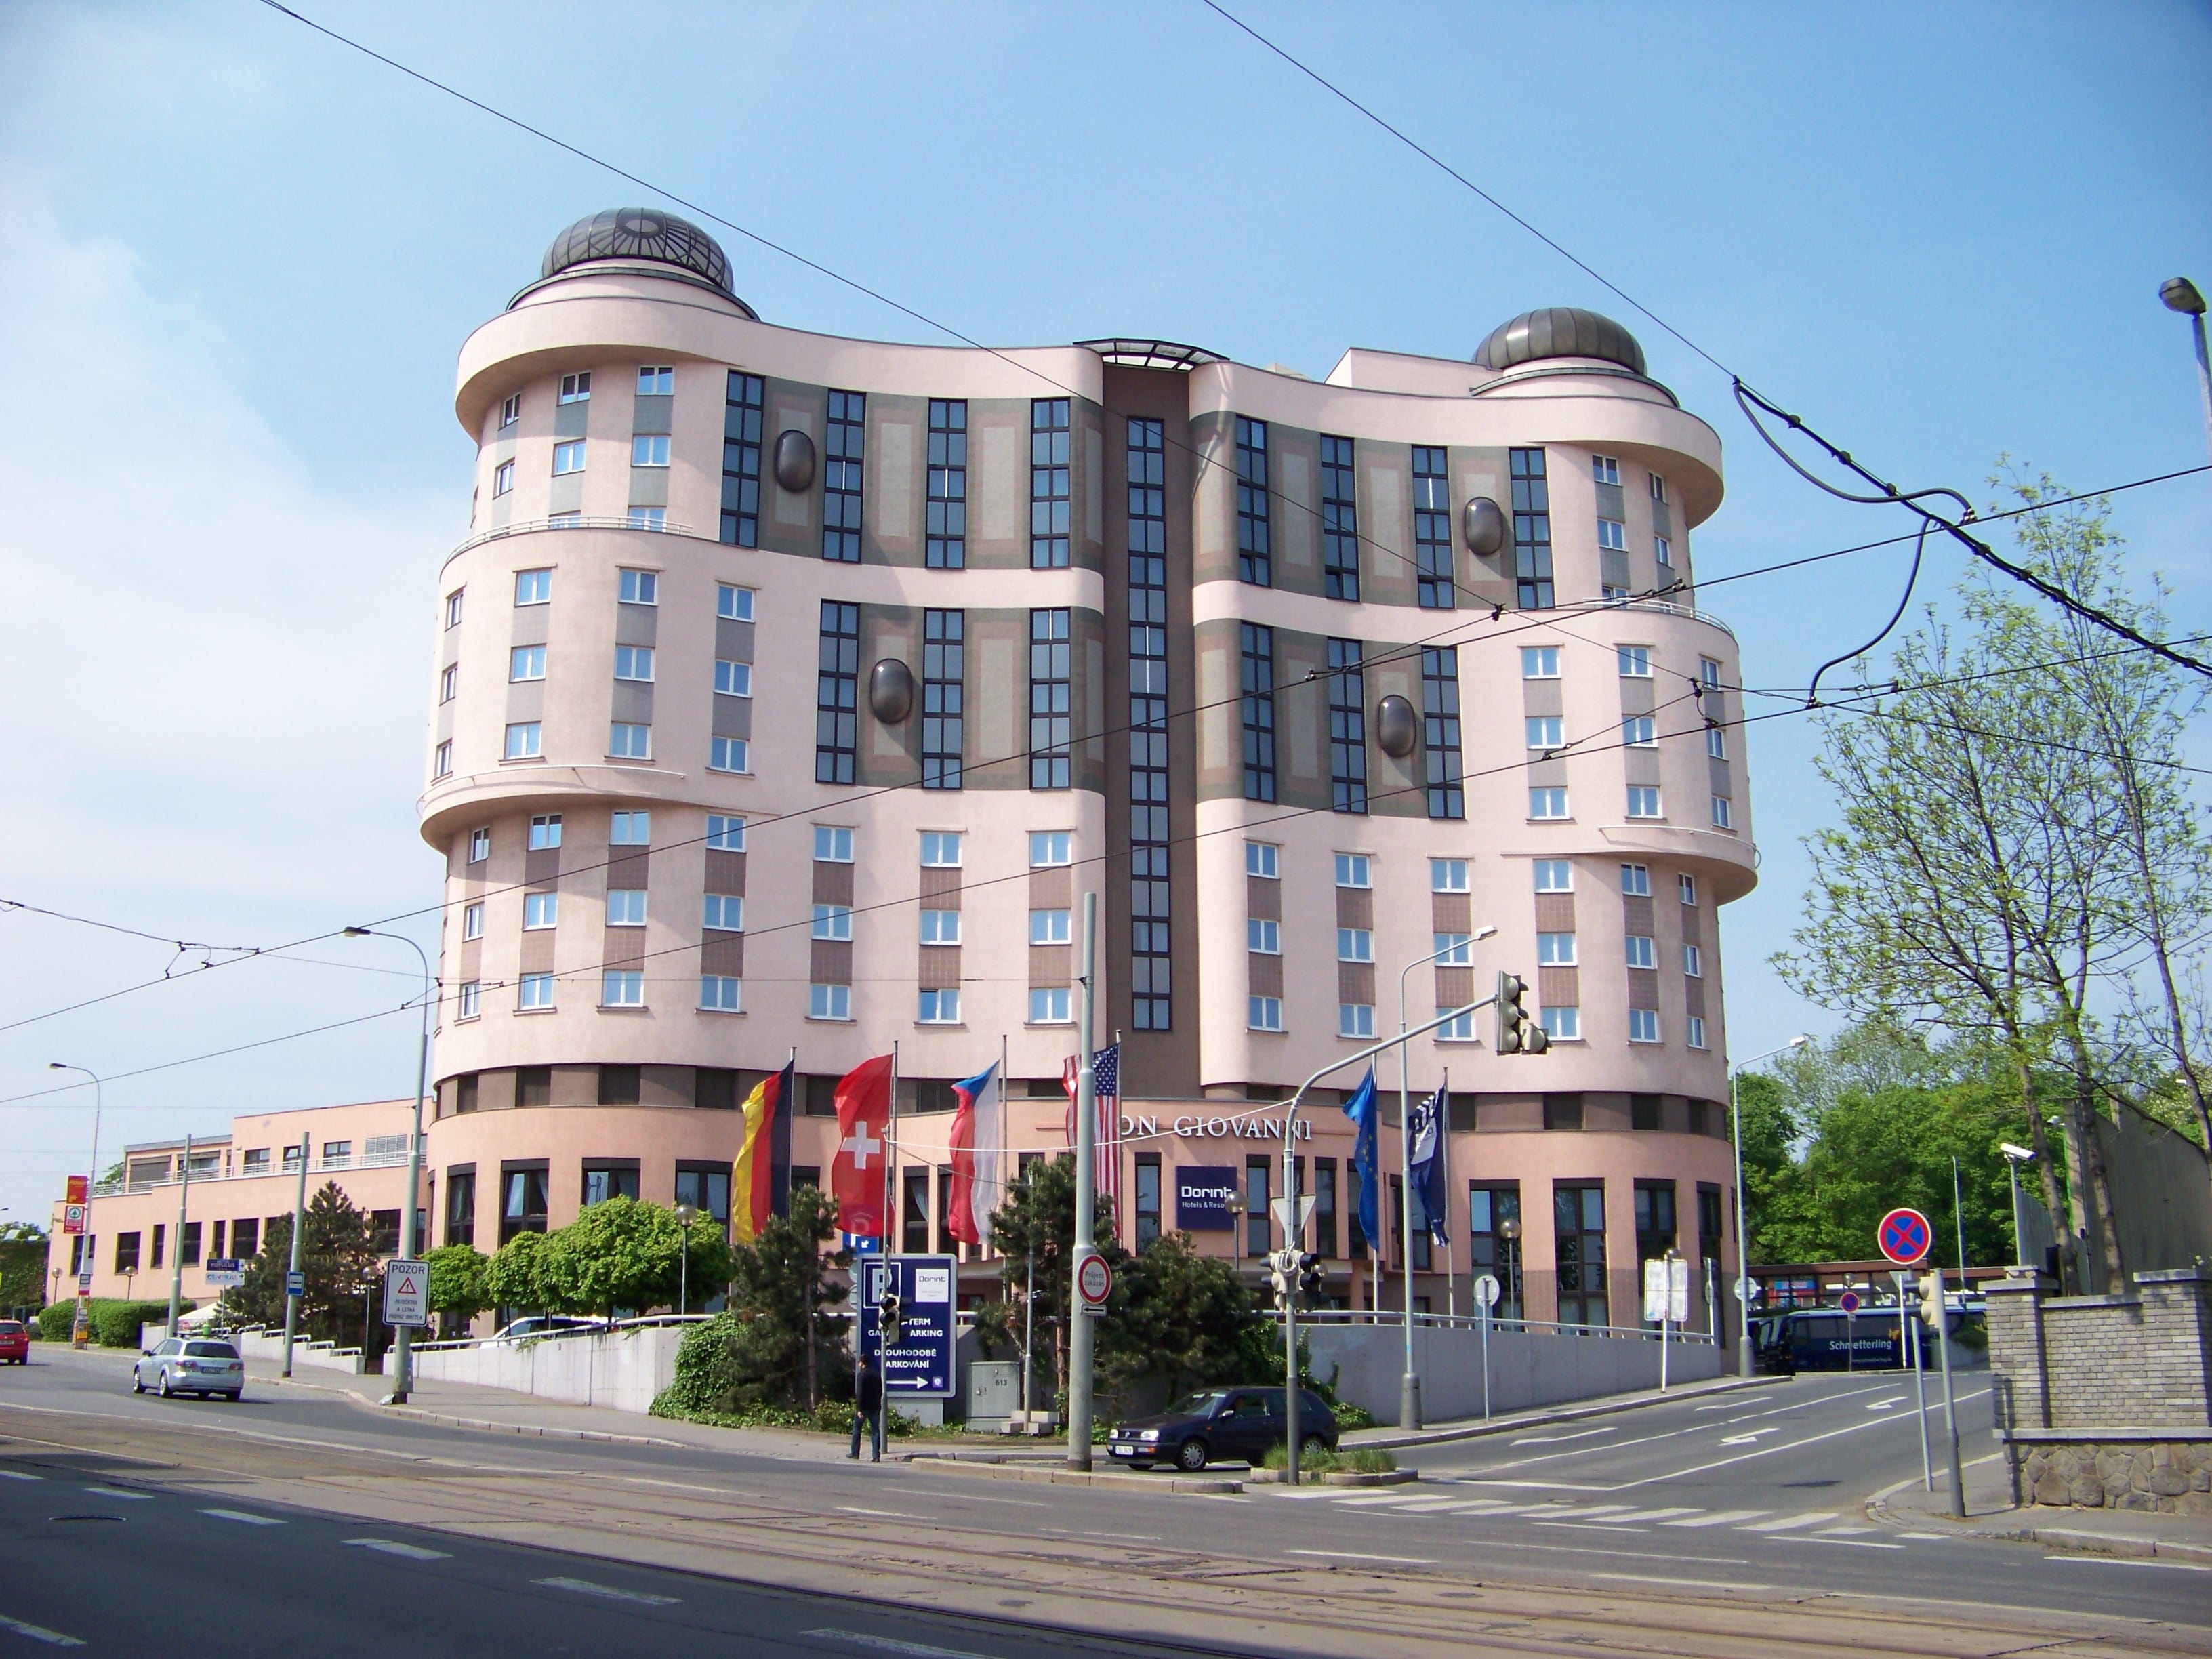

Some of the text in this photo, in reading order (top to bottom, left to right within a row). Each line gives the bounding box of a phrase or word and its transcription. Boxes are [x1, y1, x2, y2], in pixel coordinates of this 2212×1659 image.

[1122, 1115, 1158, 1135] ON
[1181, 1186, 1232, 1197] Dorint
[392, 1265, 425, 1274] POZOR
[886, 1360, 929, 1368] ARKOVÁNÍ
